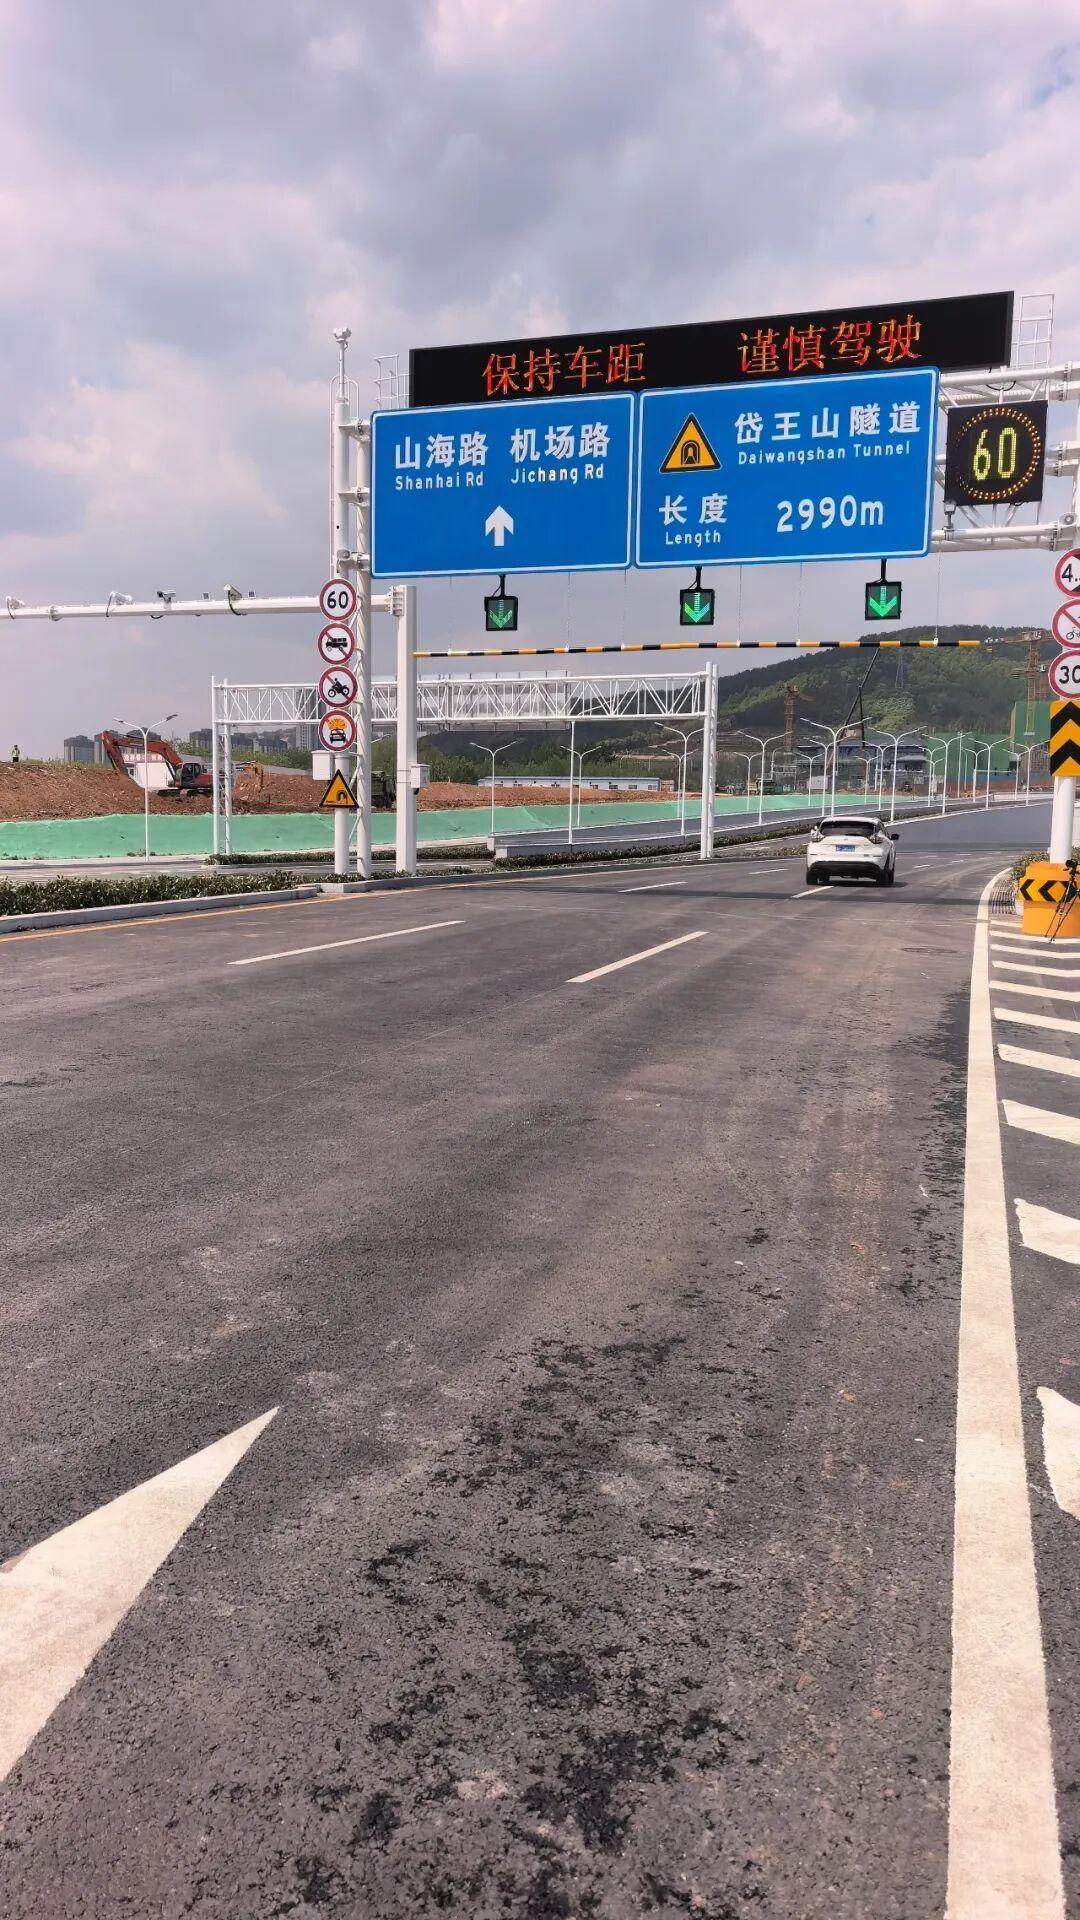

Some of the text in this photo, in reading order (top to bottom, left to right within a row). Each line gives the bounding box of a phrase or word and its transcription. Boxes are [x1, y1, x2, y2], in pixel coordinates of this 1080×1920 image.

[483, 314, 922, 396] 保持车距 谨慎驾驶
[734, 400, 921, 444] 岱王山隧道
[395, 422, 611, 470] 山海路 机场路
[738, 440, 911, 465] Daiwangshan Tunnel
[971, 426, 1018, 481] 60
[395, 471, 484, 490] Shanhai Rd
[510, 463, 604, 485] Jichang Rd
[658, 493, 728, 526] 长度
[776, 494, 885, 533] 2990m
[665, 529, 721, 548] Length
[1061, 563, 1080, 583] 4.
[327, 590, 350, 610] 60
[1059, 665, 1080, 684] 30
